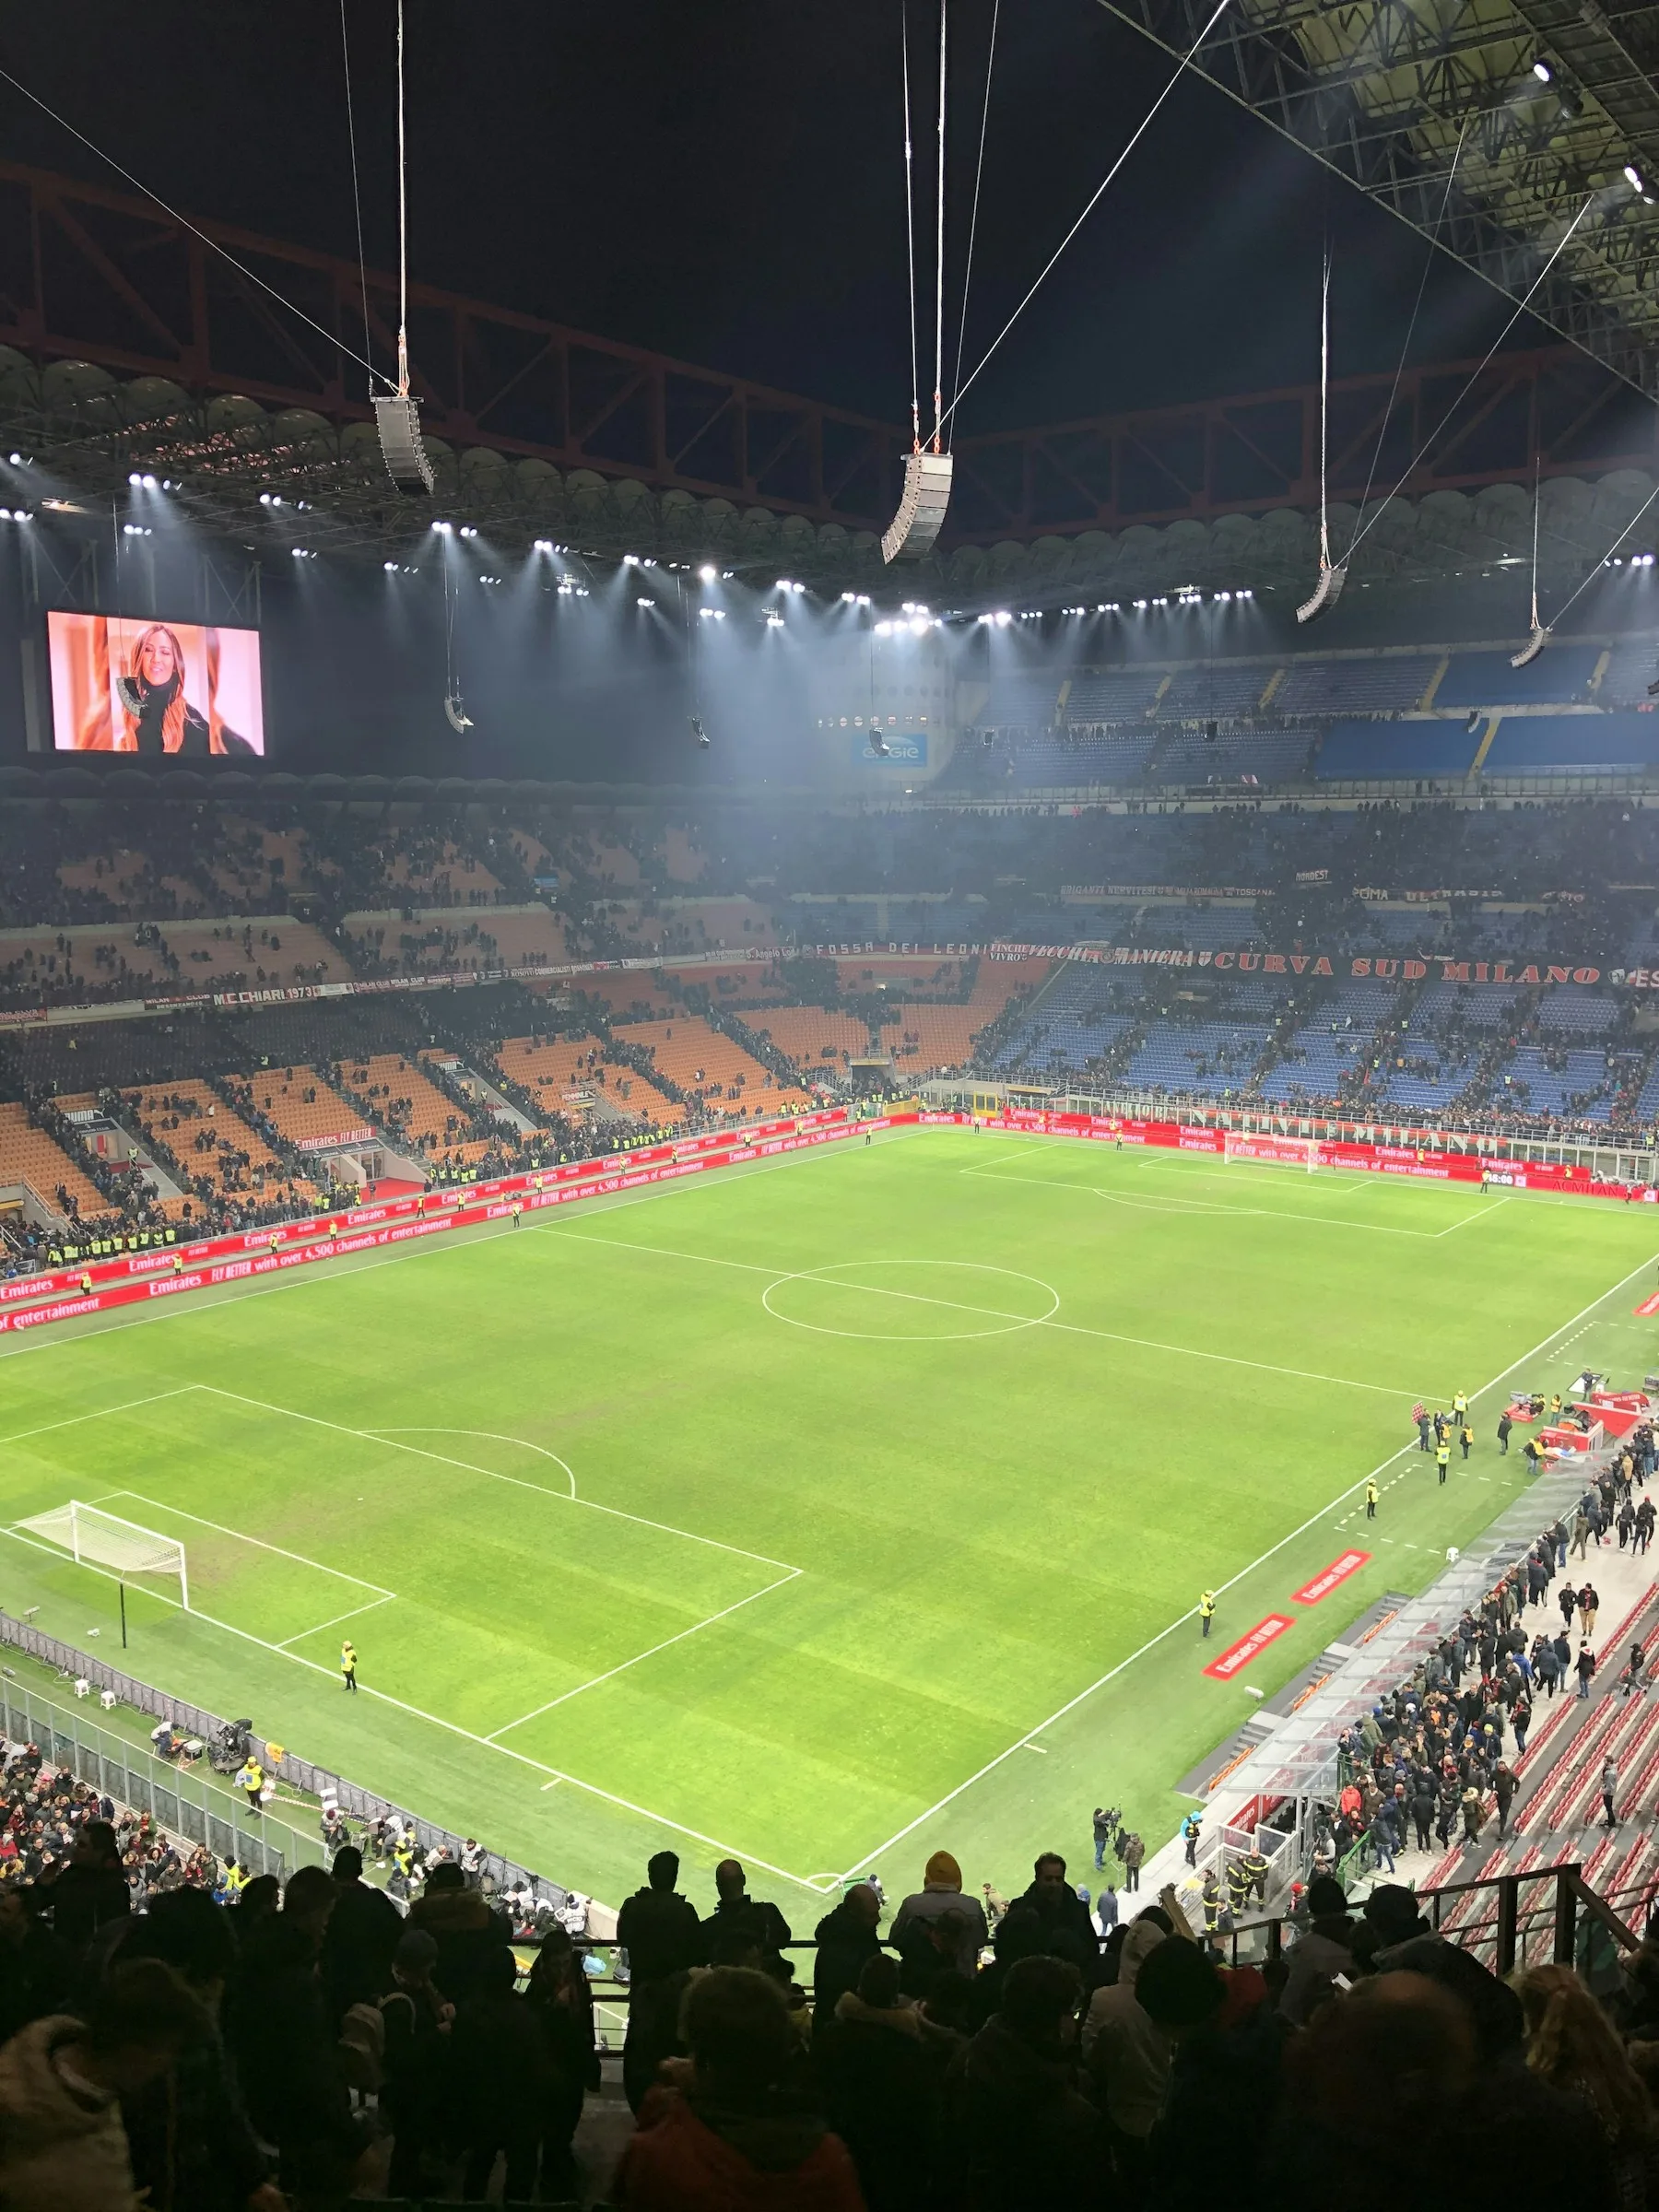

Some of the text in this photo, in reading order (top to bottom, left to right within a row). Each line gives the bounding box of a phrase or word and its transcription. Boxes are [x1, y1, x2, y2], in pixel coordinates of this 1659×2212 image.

[756, 949, 781, 960] Angelo
[816, 941, 987, 955] FOSSA DEI LEONI
[1214, 952, 1601, 984] CURVA SUD MILANO
[295, 1135, 338, 1149] Emirates
[340, 1130, 350, 1143] FLY
[351, 1127, 372, 1141] BETTER
[1180, 1126, 1215, 1137] Emirates
[1180, 1137, 1218, 1150] Emirates
[729, 1147, 757, 1162] Emirates
[1374, 1147, 1415, 1159] Emirates
[347, 1208, 387, 1225] Emirates
[149, 1275, 202, 1297] Emirates
[254, 1256, 278, 1272] with
[279, 1252, 303, 1266] over
[305, 1242, 335, 1261] 4,500
[335, 1232, 377, 1253] channels
[378, 1227, 391, 1241] of
[391, 1217, 453, 1240] entertainment
[0, 1279, 53, 1300] Emirates
[13, 1298, 100, 1325] entertainment
[1216, 1641, 1258, 1673] Emirates
